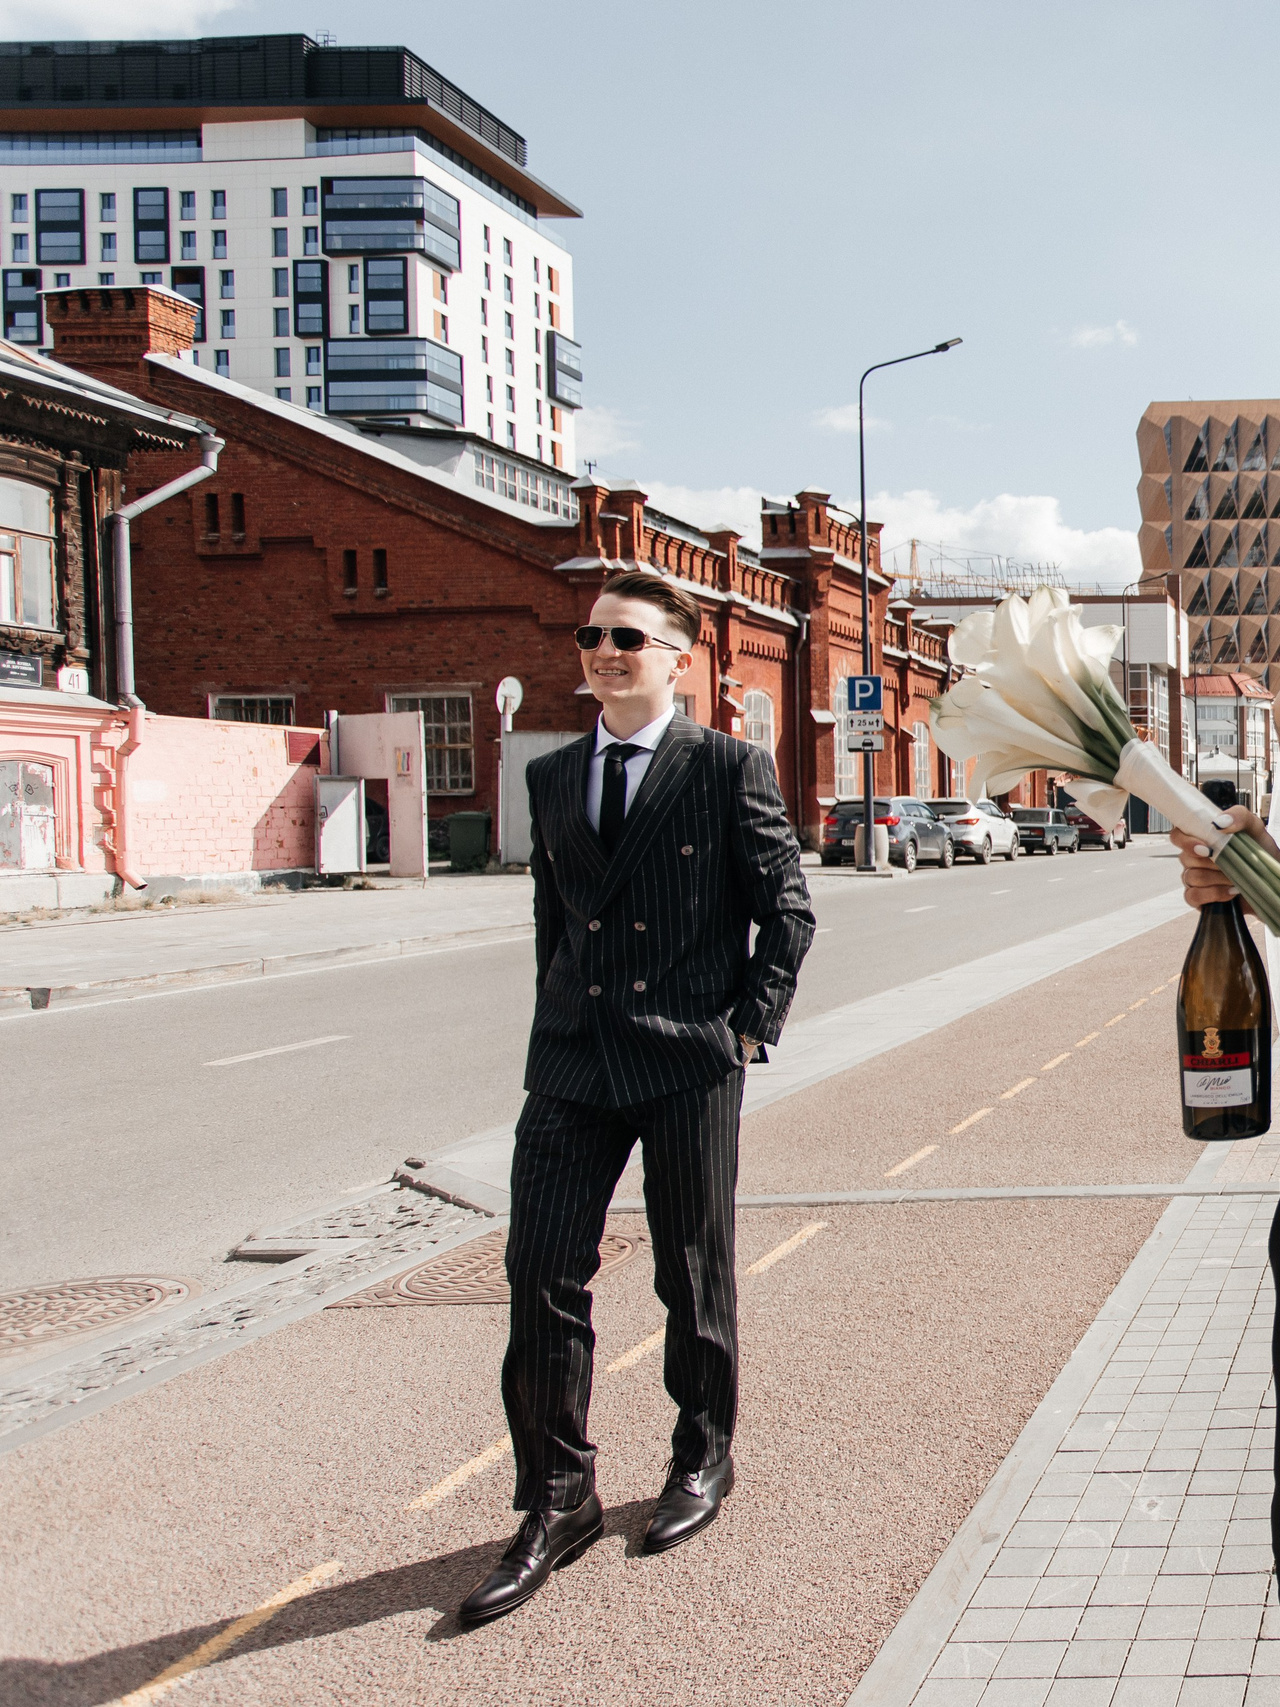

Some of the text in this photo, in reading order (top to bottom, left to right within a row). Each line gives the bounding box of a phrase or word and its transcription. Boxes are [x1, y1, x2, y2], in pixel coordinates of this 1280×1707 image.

[68, 673, 80, 689] 41
[855, 679, 874, 708] P
[857, 719, 867, 727] 25
[1190, 1057, 1239, 1065] CHIARLI
